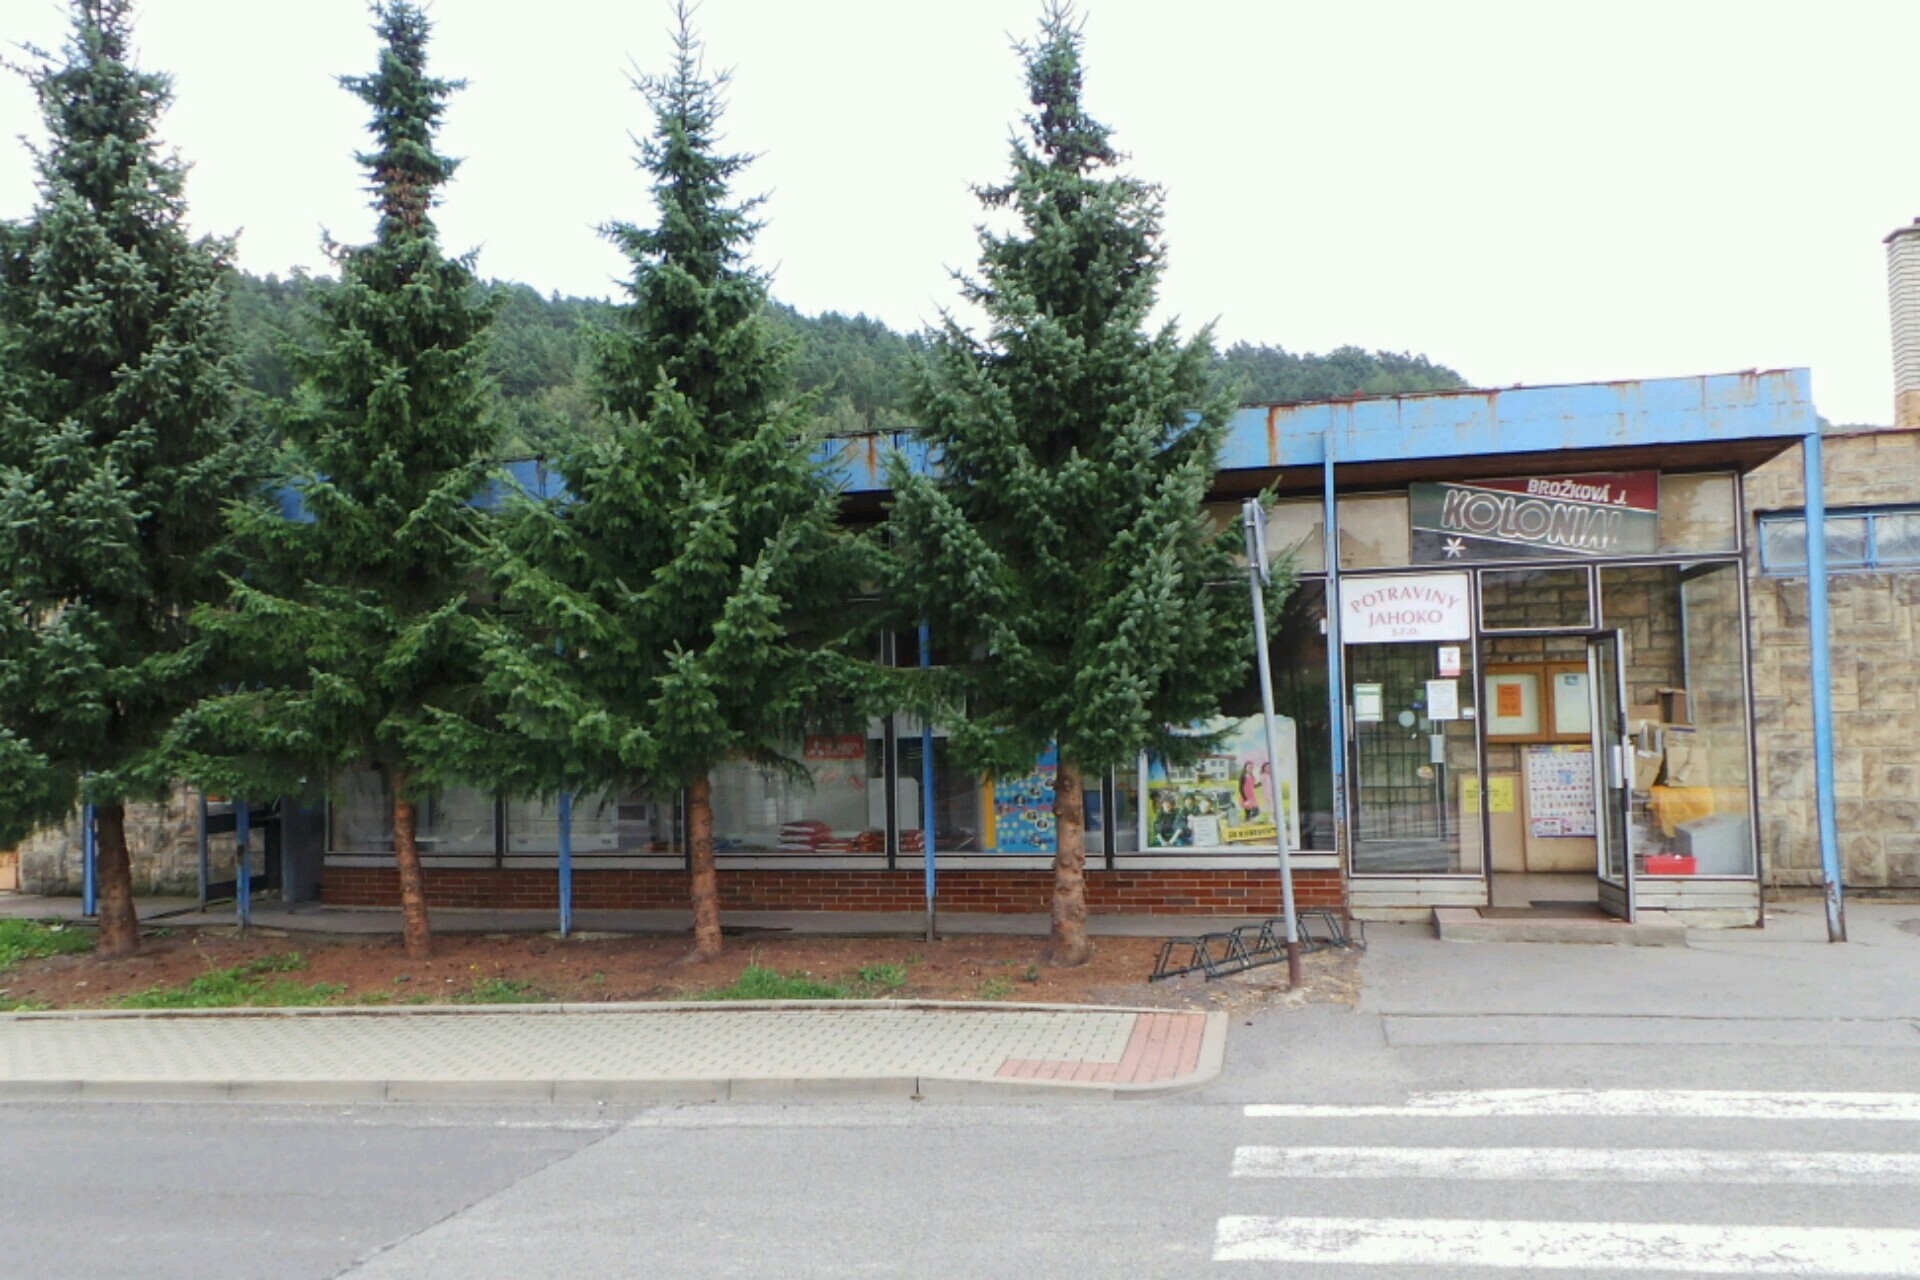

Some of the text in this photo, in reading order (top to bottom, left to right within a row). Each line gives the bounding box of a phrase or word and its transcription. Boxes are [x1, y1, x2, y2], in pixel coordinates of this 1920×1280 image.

[1527, 478, 1611, 503] BROŽKOVÁ
[1350, 585, 1460, 613] POTRAVINY
[1368, 609, 1443, 628] JAHOKO
